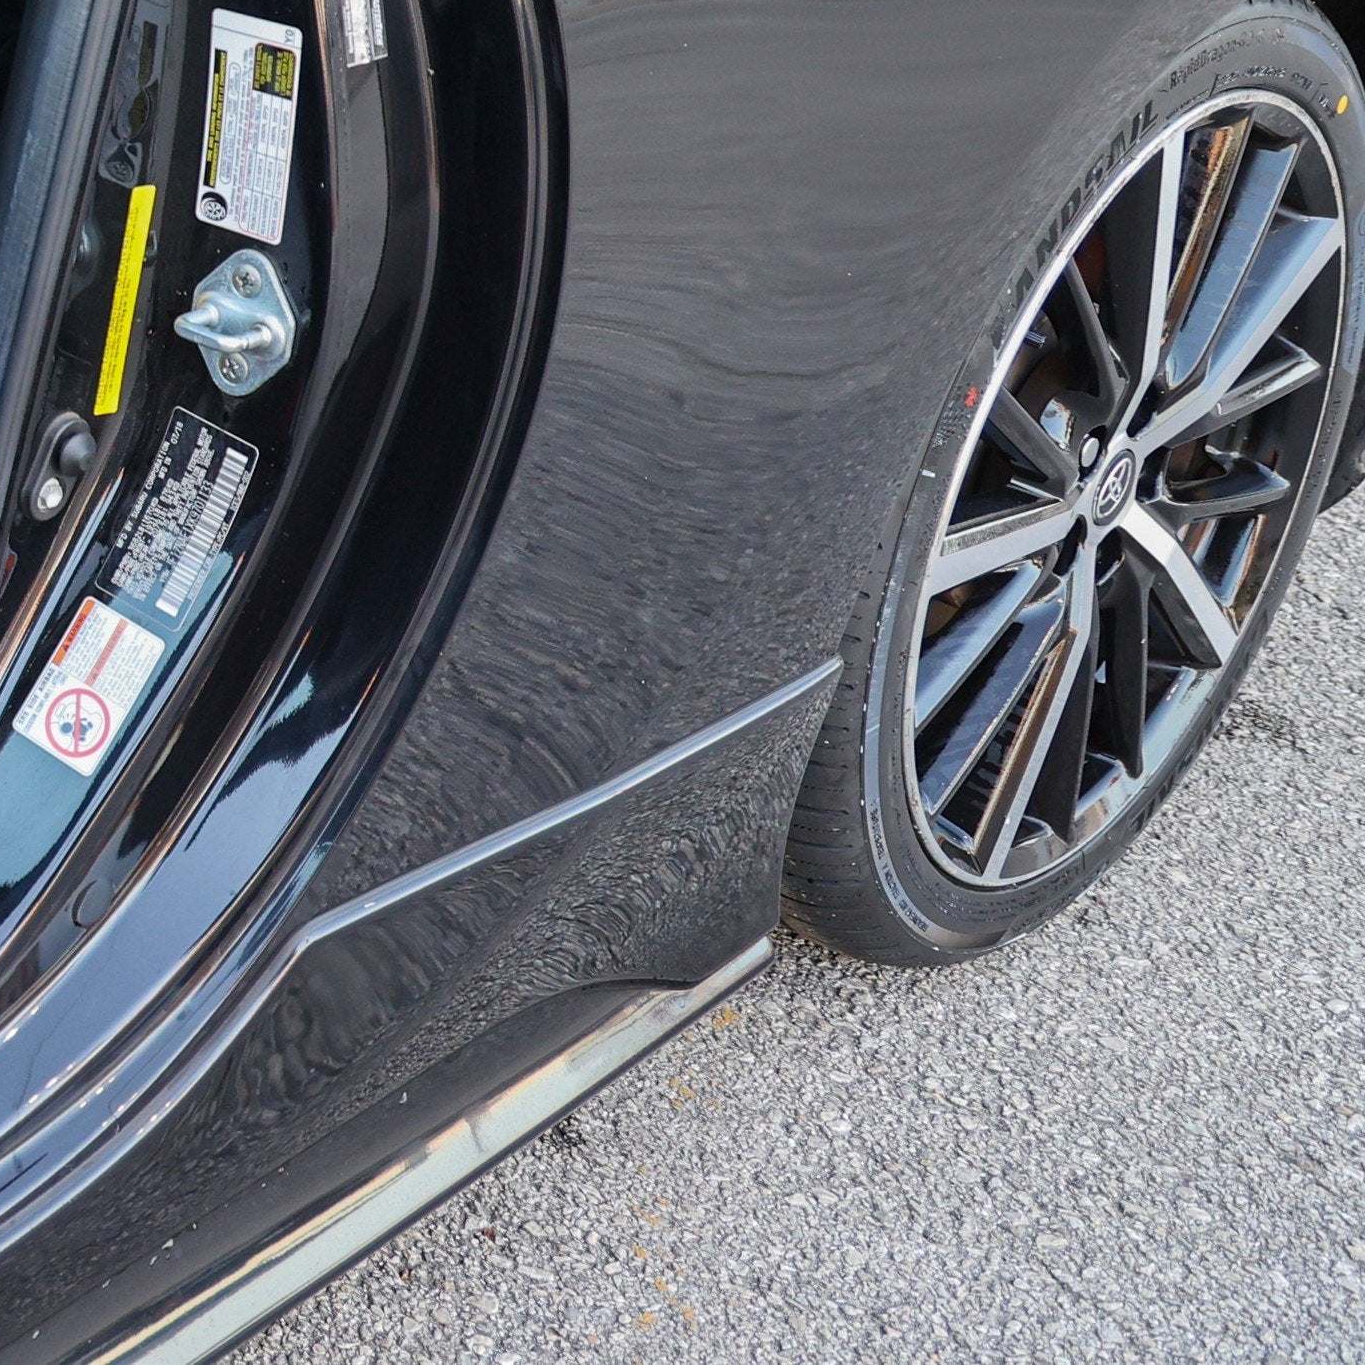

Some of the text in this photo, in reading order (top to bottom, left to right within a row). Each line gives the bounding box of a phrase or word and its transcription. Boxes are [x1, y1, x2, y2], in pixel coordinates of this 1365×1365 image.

[169, 420, 184, 445] 07/18
[124, 519, 134, 532] BY
[131, 490, 147, 519] SUBARU
[145, 440, 170, 490] CORPORATION
[26, 693, 39, 710] SIDE
[37, 666, 56, 692] AIRBAG
